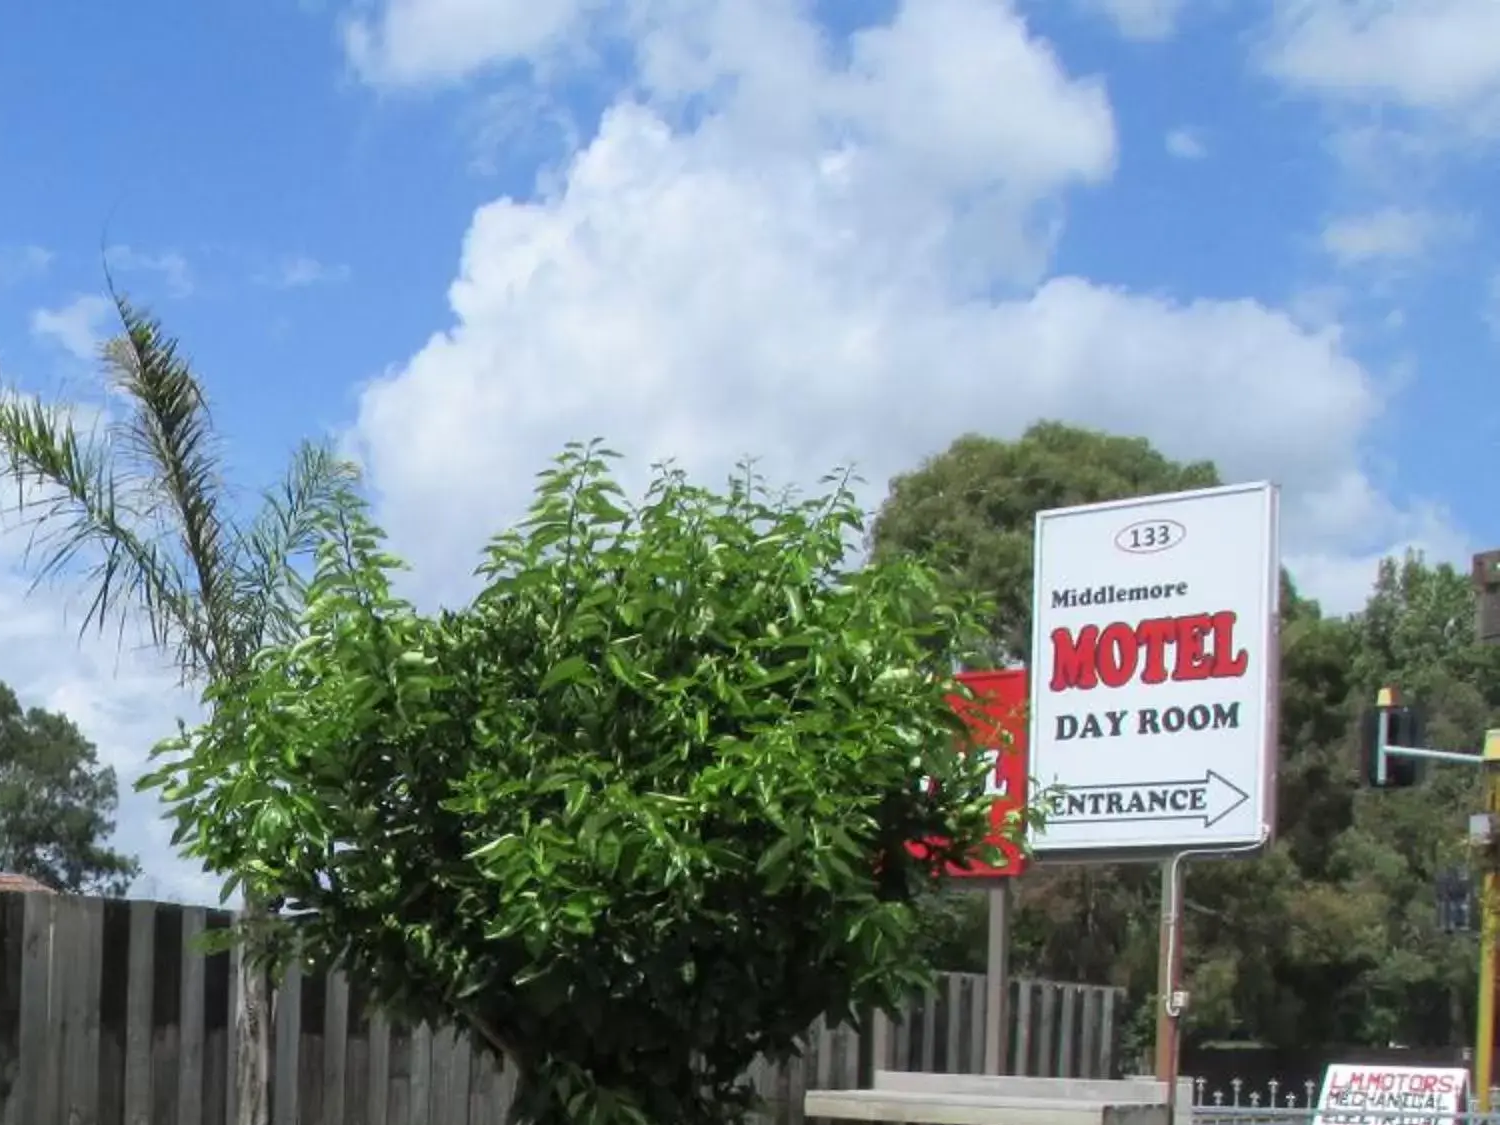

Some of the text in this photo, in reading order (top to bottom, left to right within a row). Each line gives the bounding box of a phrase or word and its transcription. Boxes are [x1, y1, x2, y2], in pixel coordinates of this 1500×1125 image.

[1129, 525, 1171, 549] 133
[1051, 580, 1188, 609] Middlemore
[1049, 610, 1249, 692] MOTEL
[1055, 702, 1240, 741] DAY ROOM
[1052, 788, 1208, 816] ENTRANCE
[1327, 1090, 1449, 1110] MECHANICAL
